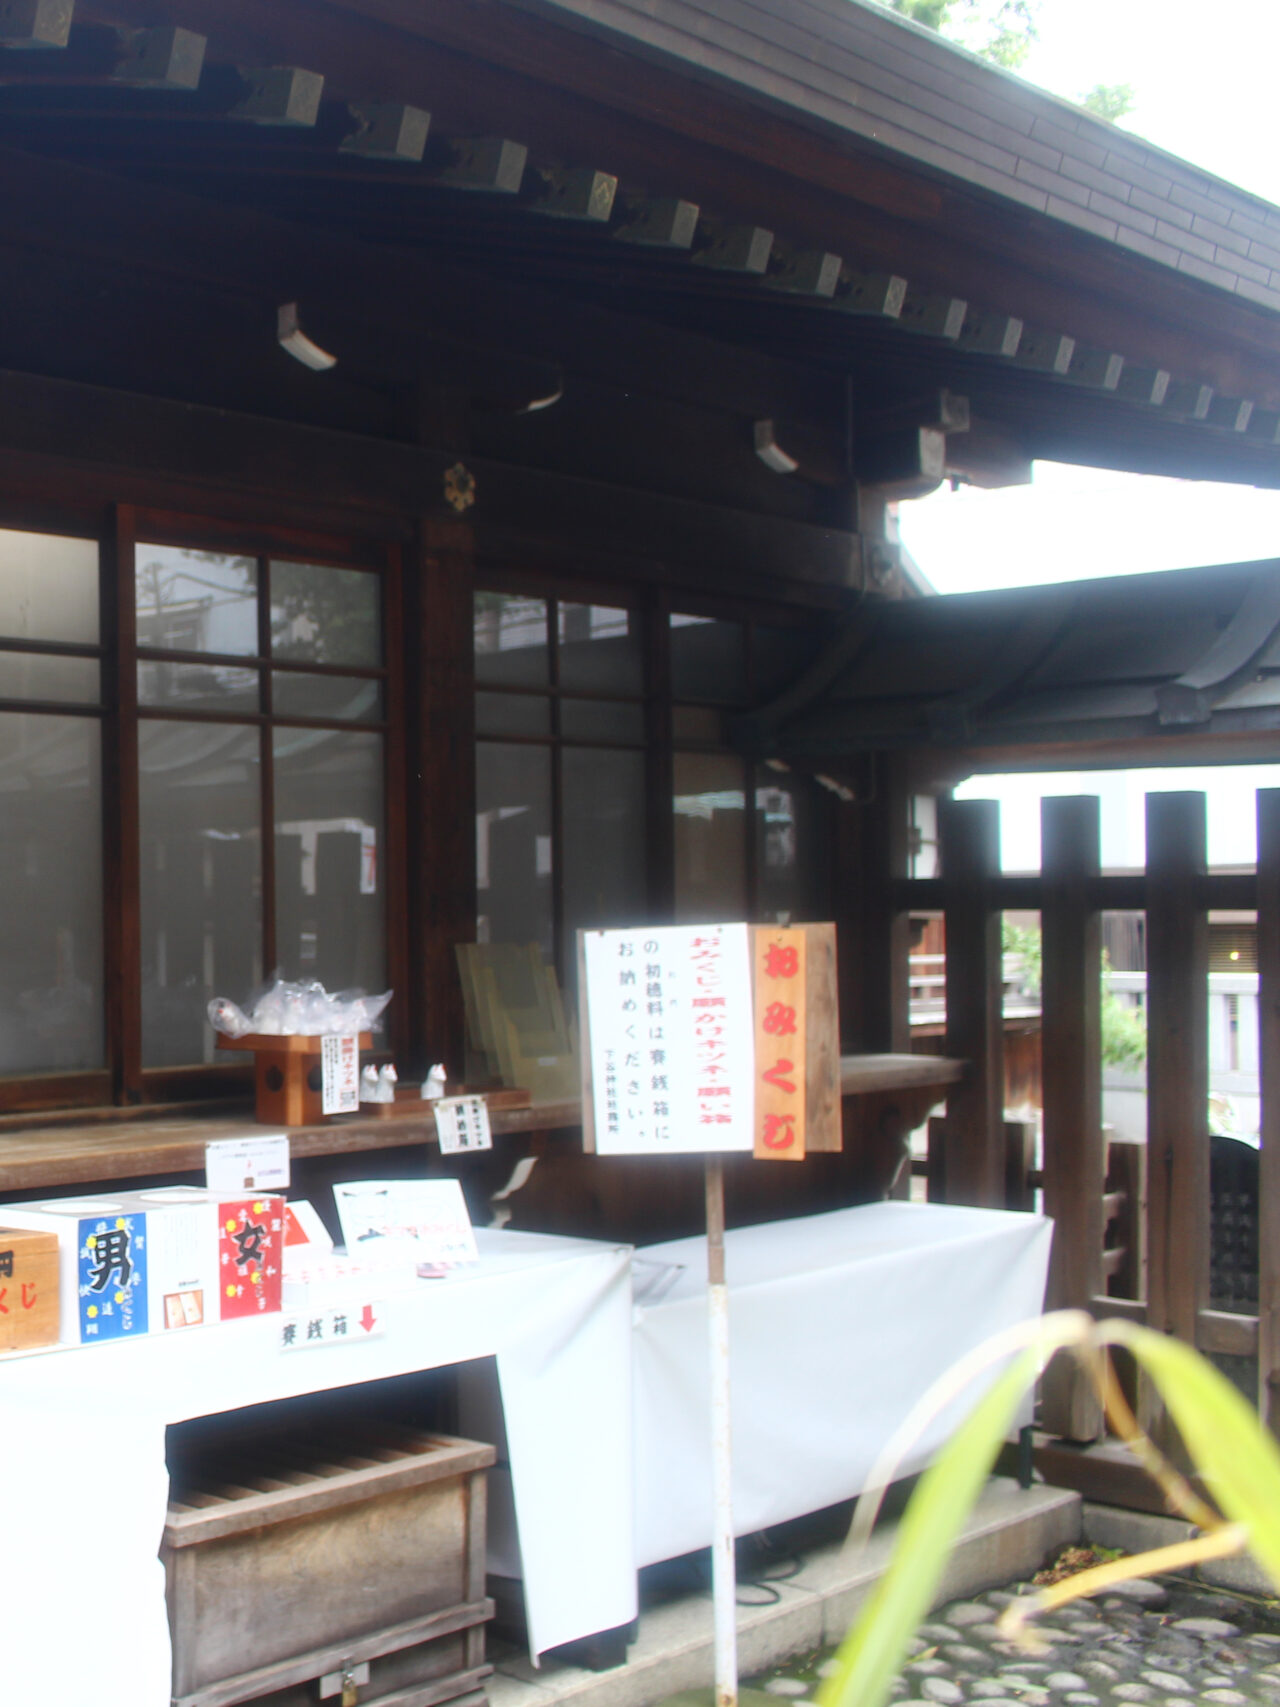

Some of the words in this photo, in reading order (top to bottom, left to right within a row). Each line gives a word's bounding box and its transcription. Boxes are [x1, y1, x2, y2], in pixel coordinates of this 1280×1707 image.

[618, 942, 644, 1138] お納めください。
[643, 939, 670, 1140] の初穂料は賽銭箱に
[762, 943, 799, 1150] おみくじ
[89, 1229, 132, 1291] 男
[233, 1219, 267, 1267] 女
[281, 1314, 348, 1347] 賽銭箱
